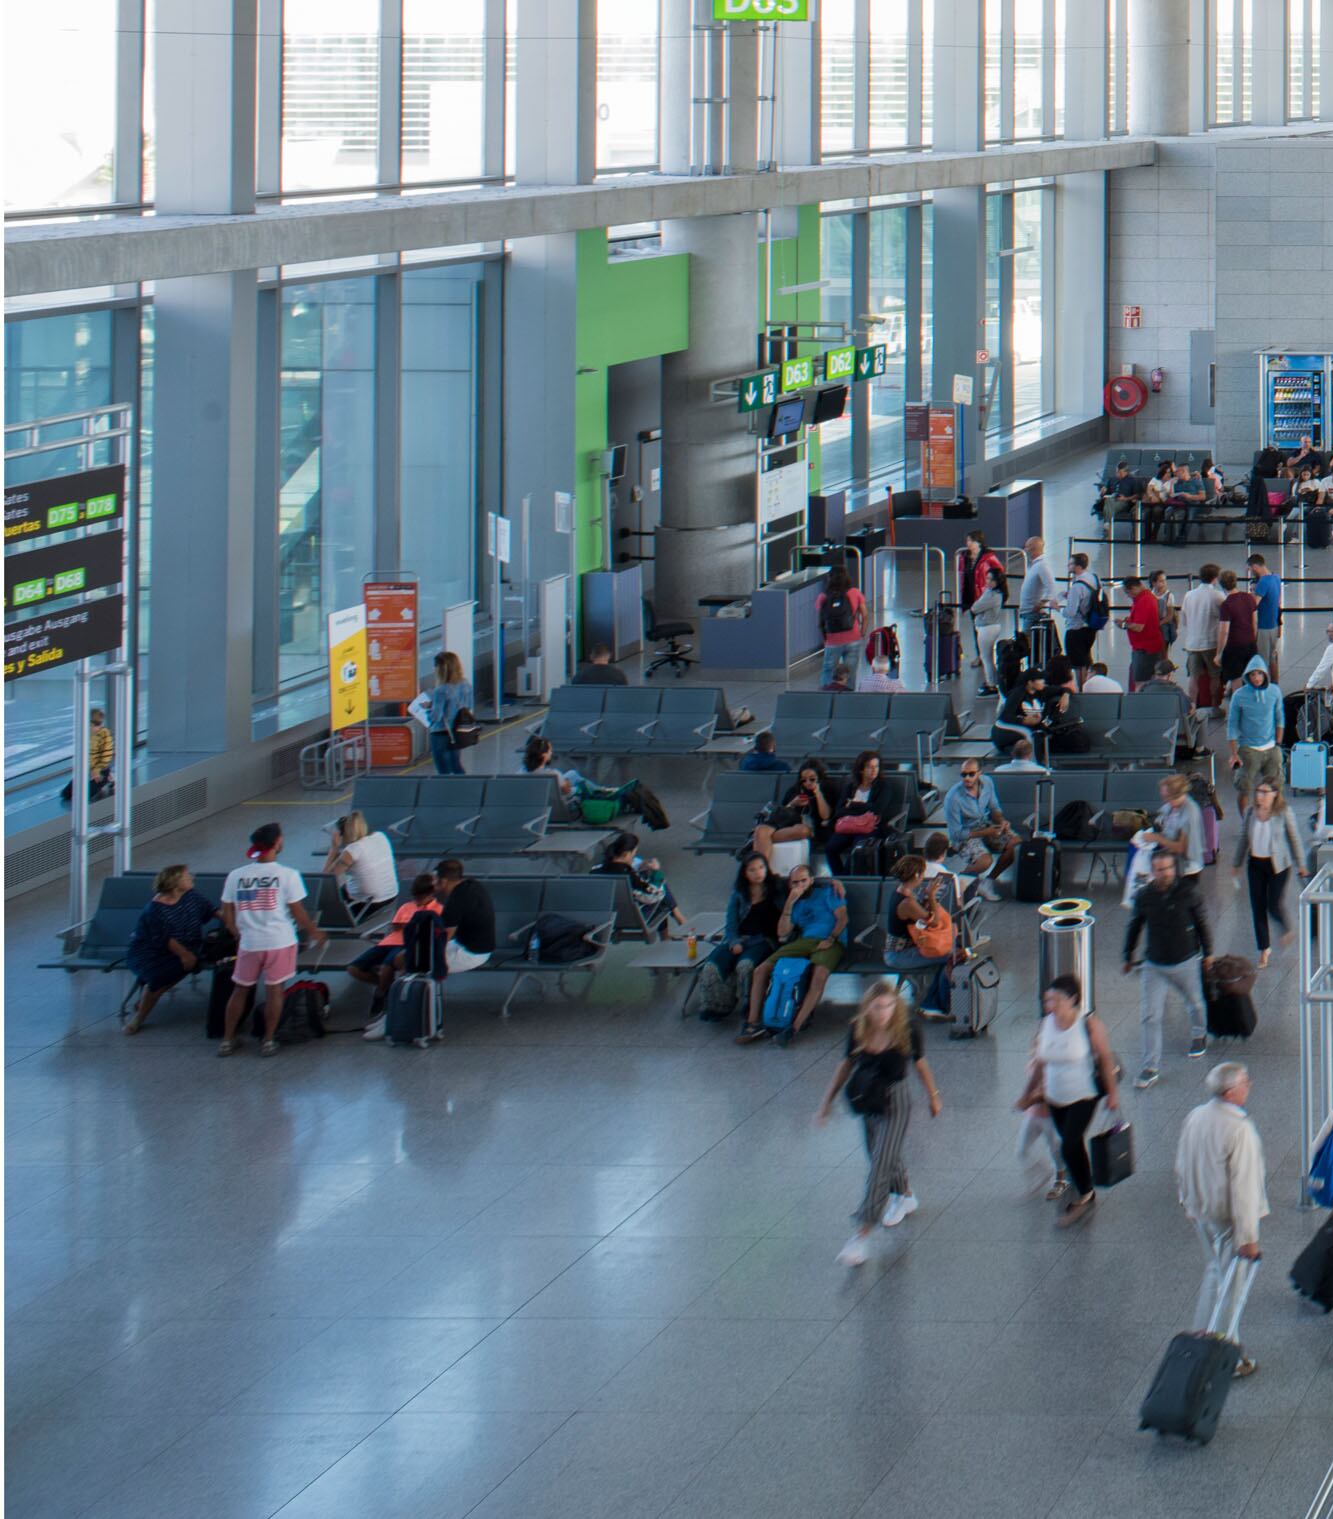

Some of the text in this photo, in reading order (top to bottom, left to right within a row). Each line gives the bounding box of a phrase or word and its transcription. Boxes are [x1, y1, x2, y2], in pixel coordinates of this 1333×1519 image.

[830, 352, 852, 374] D62
[786, 362, 809, 386] D63
[4, 493, 29, 506] ates
[49, 506, 76, 524] D75
[87, 498, 113, 515] D78
[4, 520, 41, 537] uertas
[16, 582, 43, 601] D64
[8, 636, 49, 656] and exit
[28, 648, 64, 666] Salida
[238, 876, 280, 888] NASA
